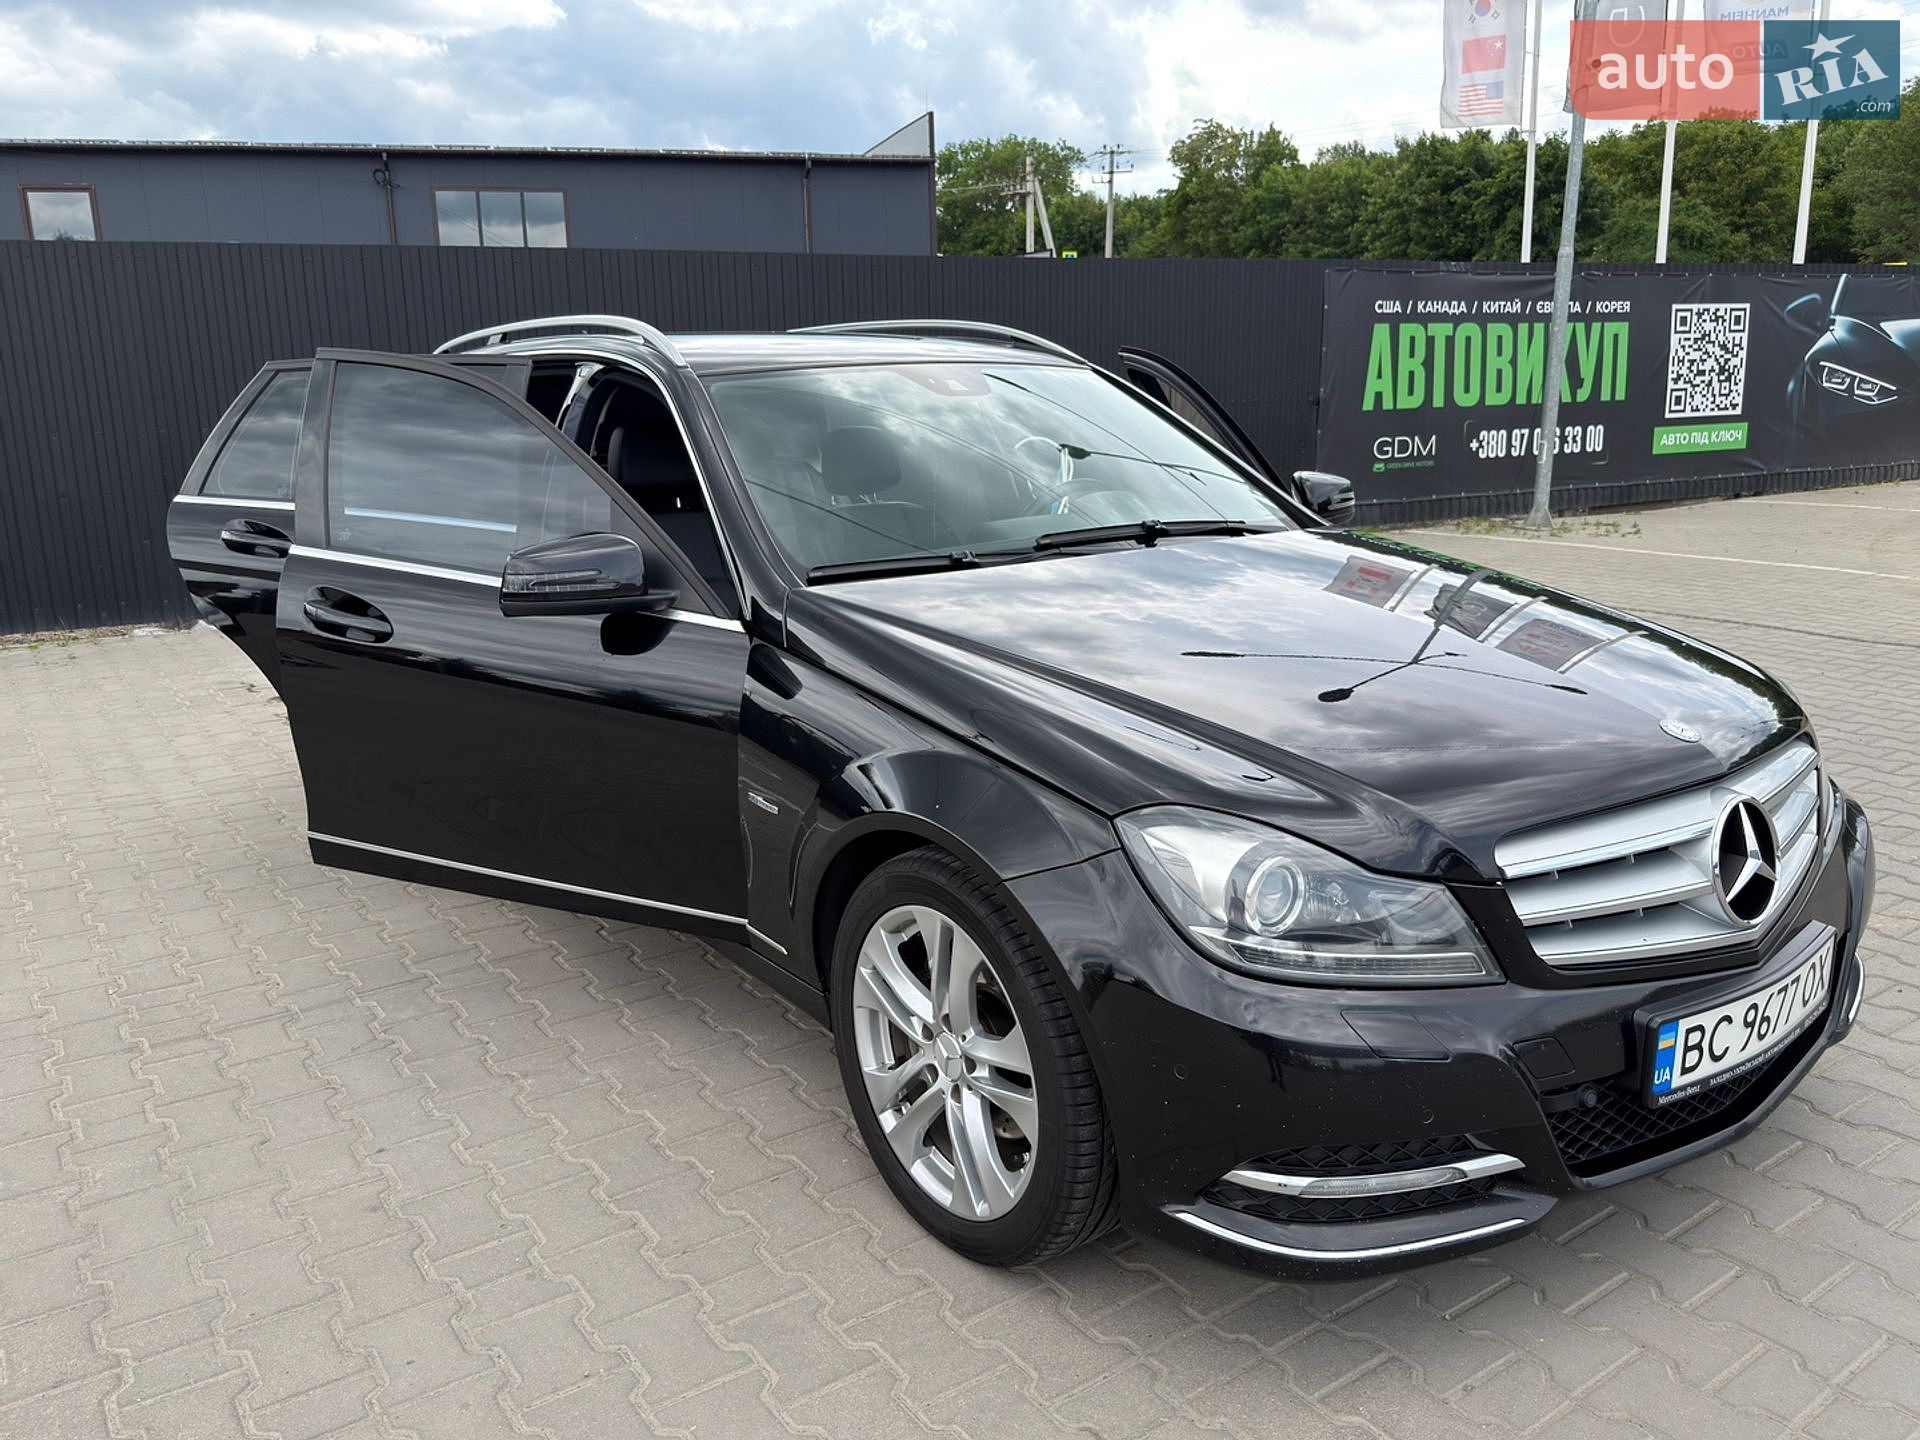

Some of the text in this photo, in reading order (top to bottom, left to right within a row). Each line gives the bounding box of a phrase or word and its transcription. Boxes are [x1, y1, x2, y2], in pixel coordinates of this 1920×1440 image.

[1374, 300, 1402, 314] США
[1417, 300, 1468, 315] КАНАДА
[1482, 298, 1522, 314] КИТАЙ
[1536, 300, 1582, 314] ЄВПА
[1595, 300, 1631, 314] КОРЕЯ
[1373, 434, 1436, 459] GDM
[1469, 424, 1605, 459] +380 97 06 33 00
[1660, 429, 1743, 446] АВТО ПІД КЛЮЧ
[1680, 1014, 1734, 1076] BC
[1738, 973, 1802, 1054] 9677
[1802, 945, 1831, 1008] OX
[1654, 1066, 1671, 1085] UA
